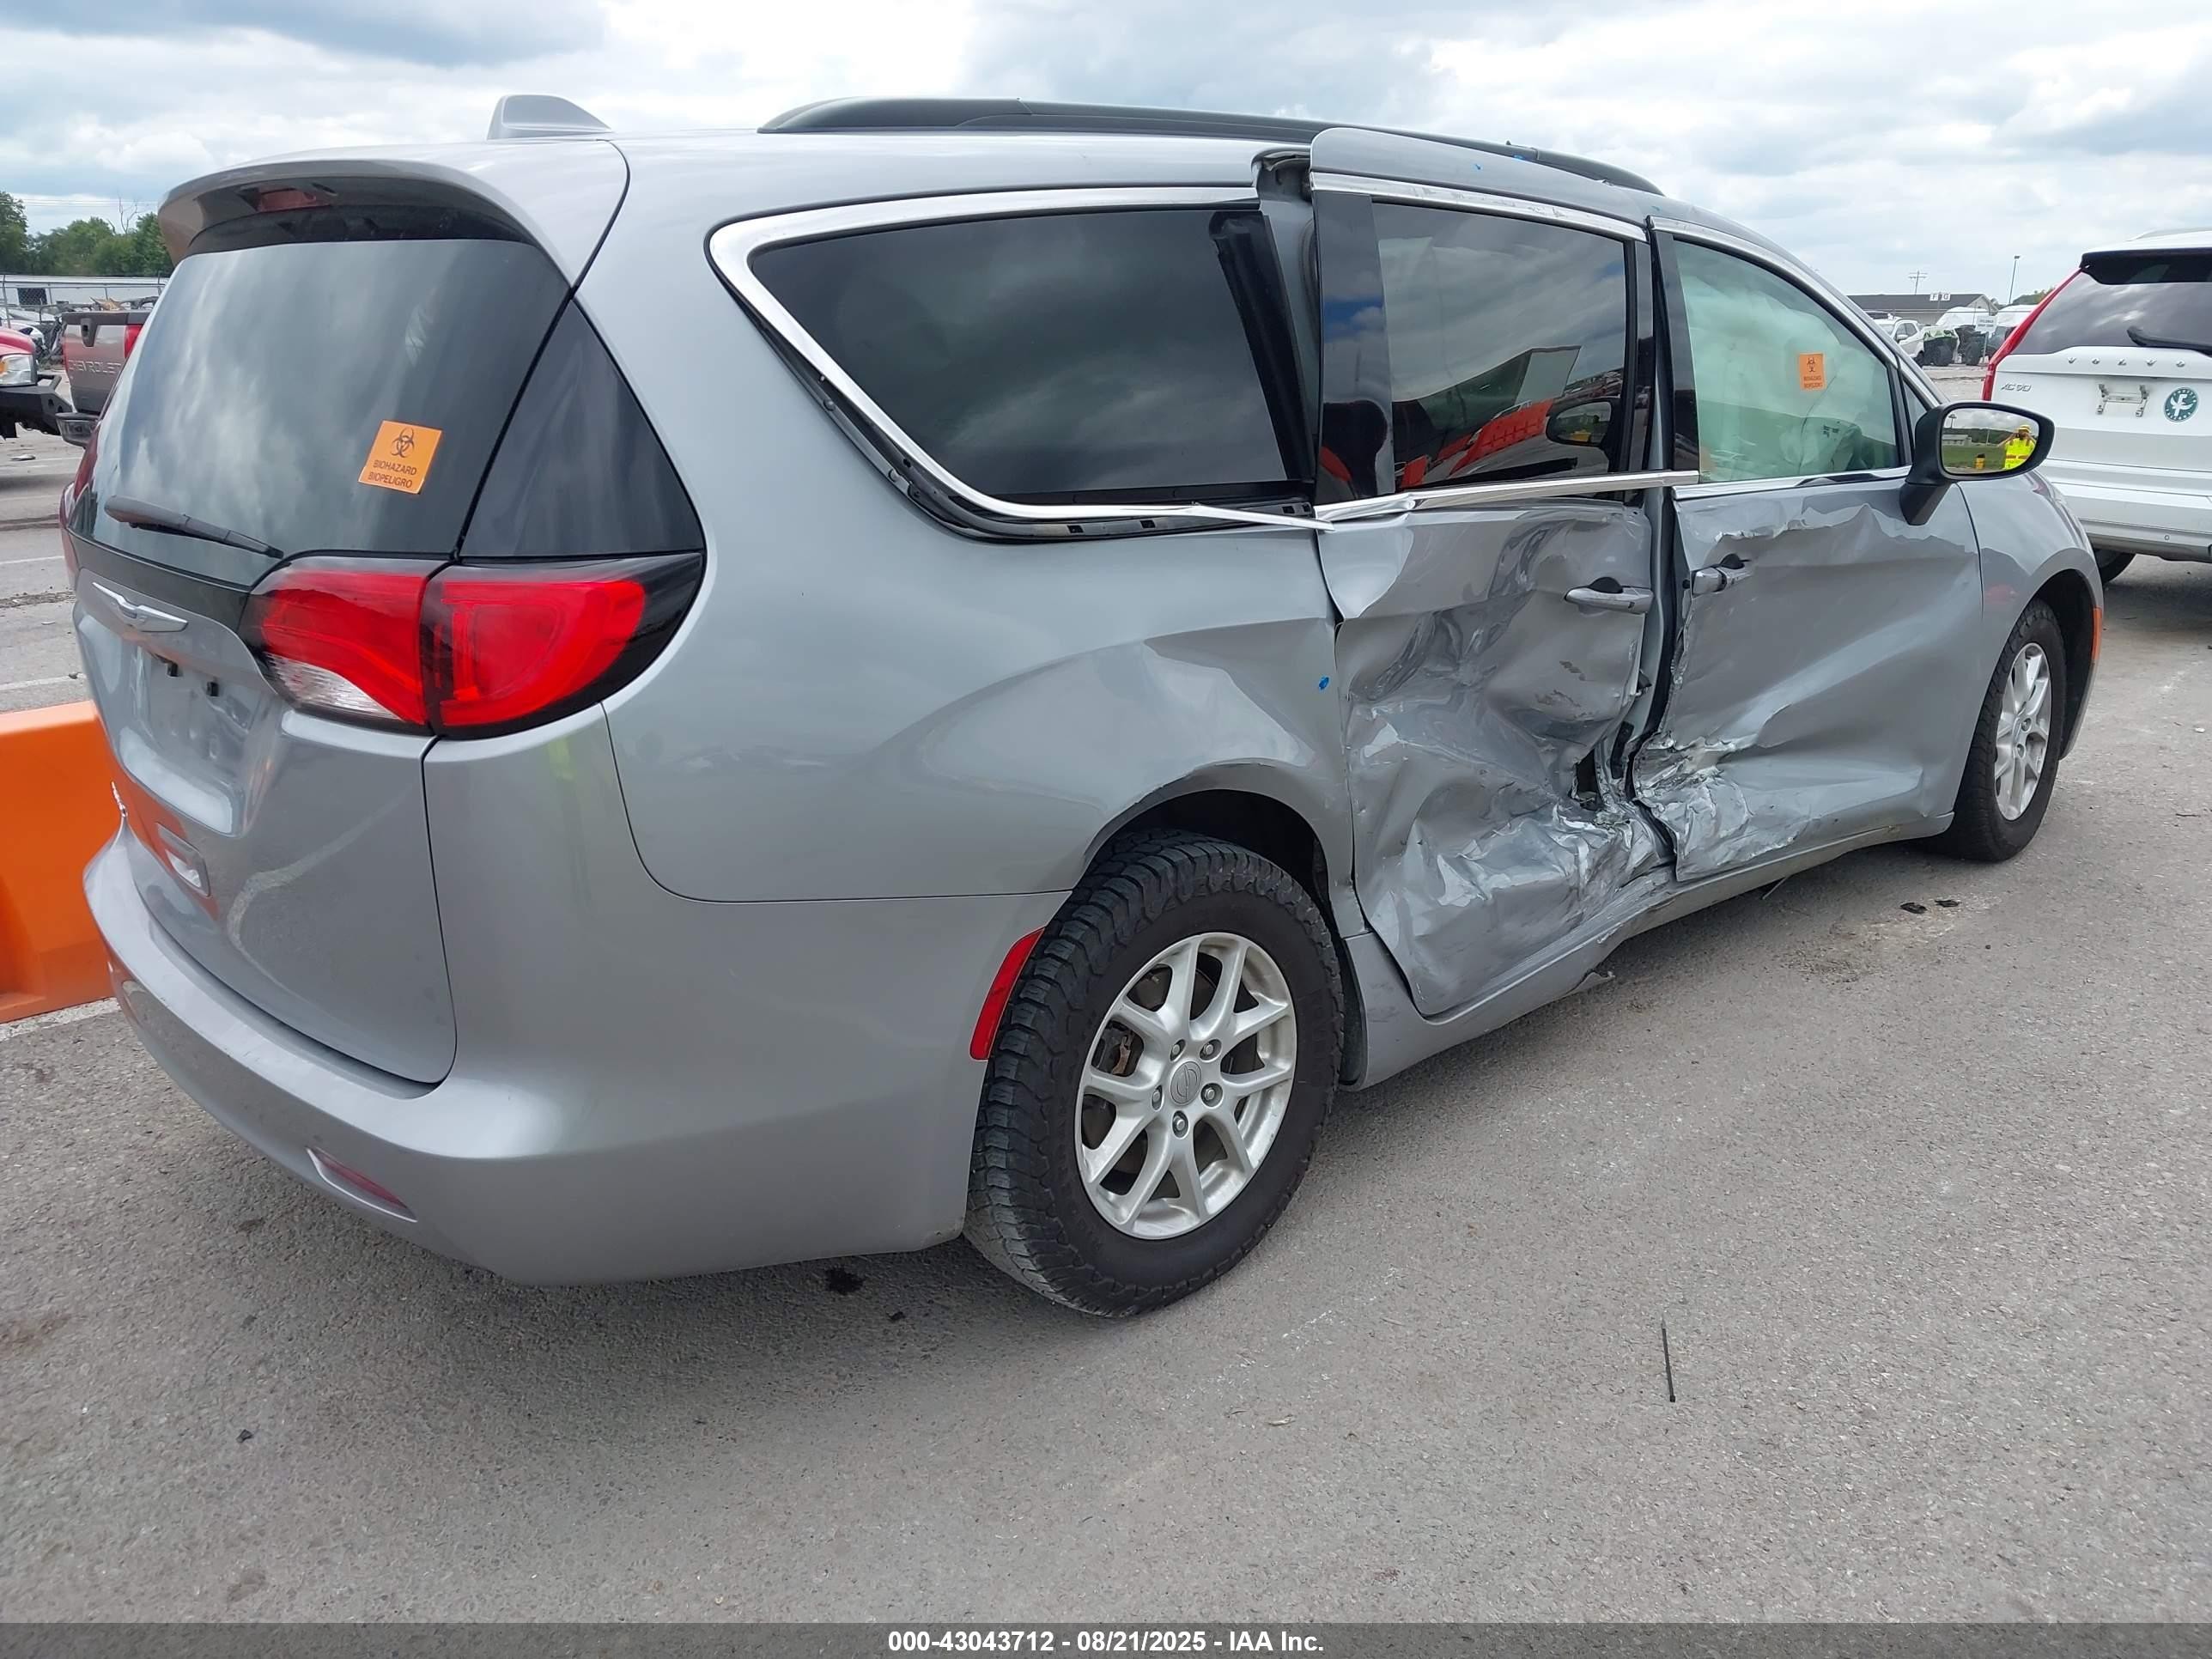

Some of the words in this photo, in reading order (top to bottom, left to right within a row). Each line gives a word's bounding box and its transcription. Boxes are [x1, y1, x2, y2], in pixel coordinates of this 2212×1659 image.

[68, 359, 122, 374] CHEVROLET
[2068, 356, 2186, 368] VOLVO
[373, 459, 417, 476] BIOHAZARD
[368, 471, 413, 489] BIOPELIGRO
